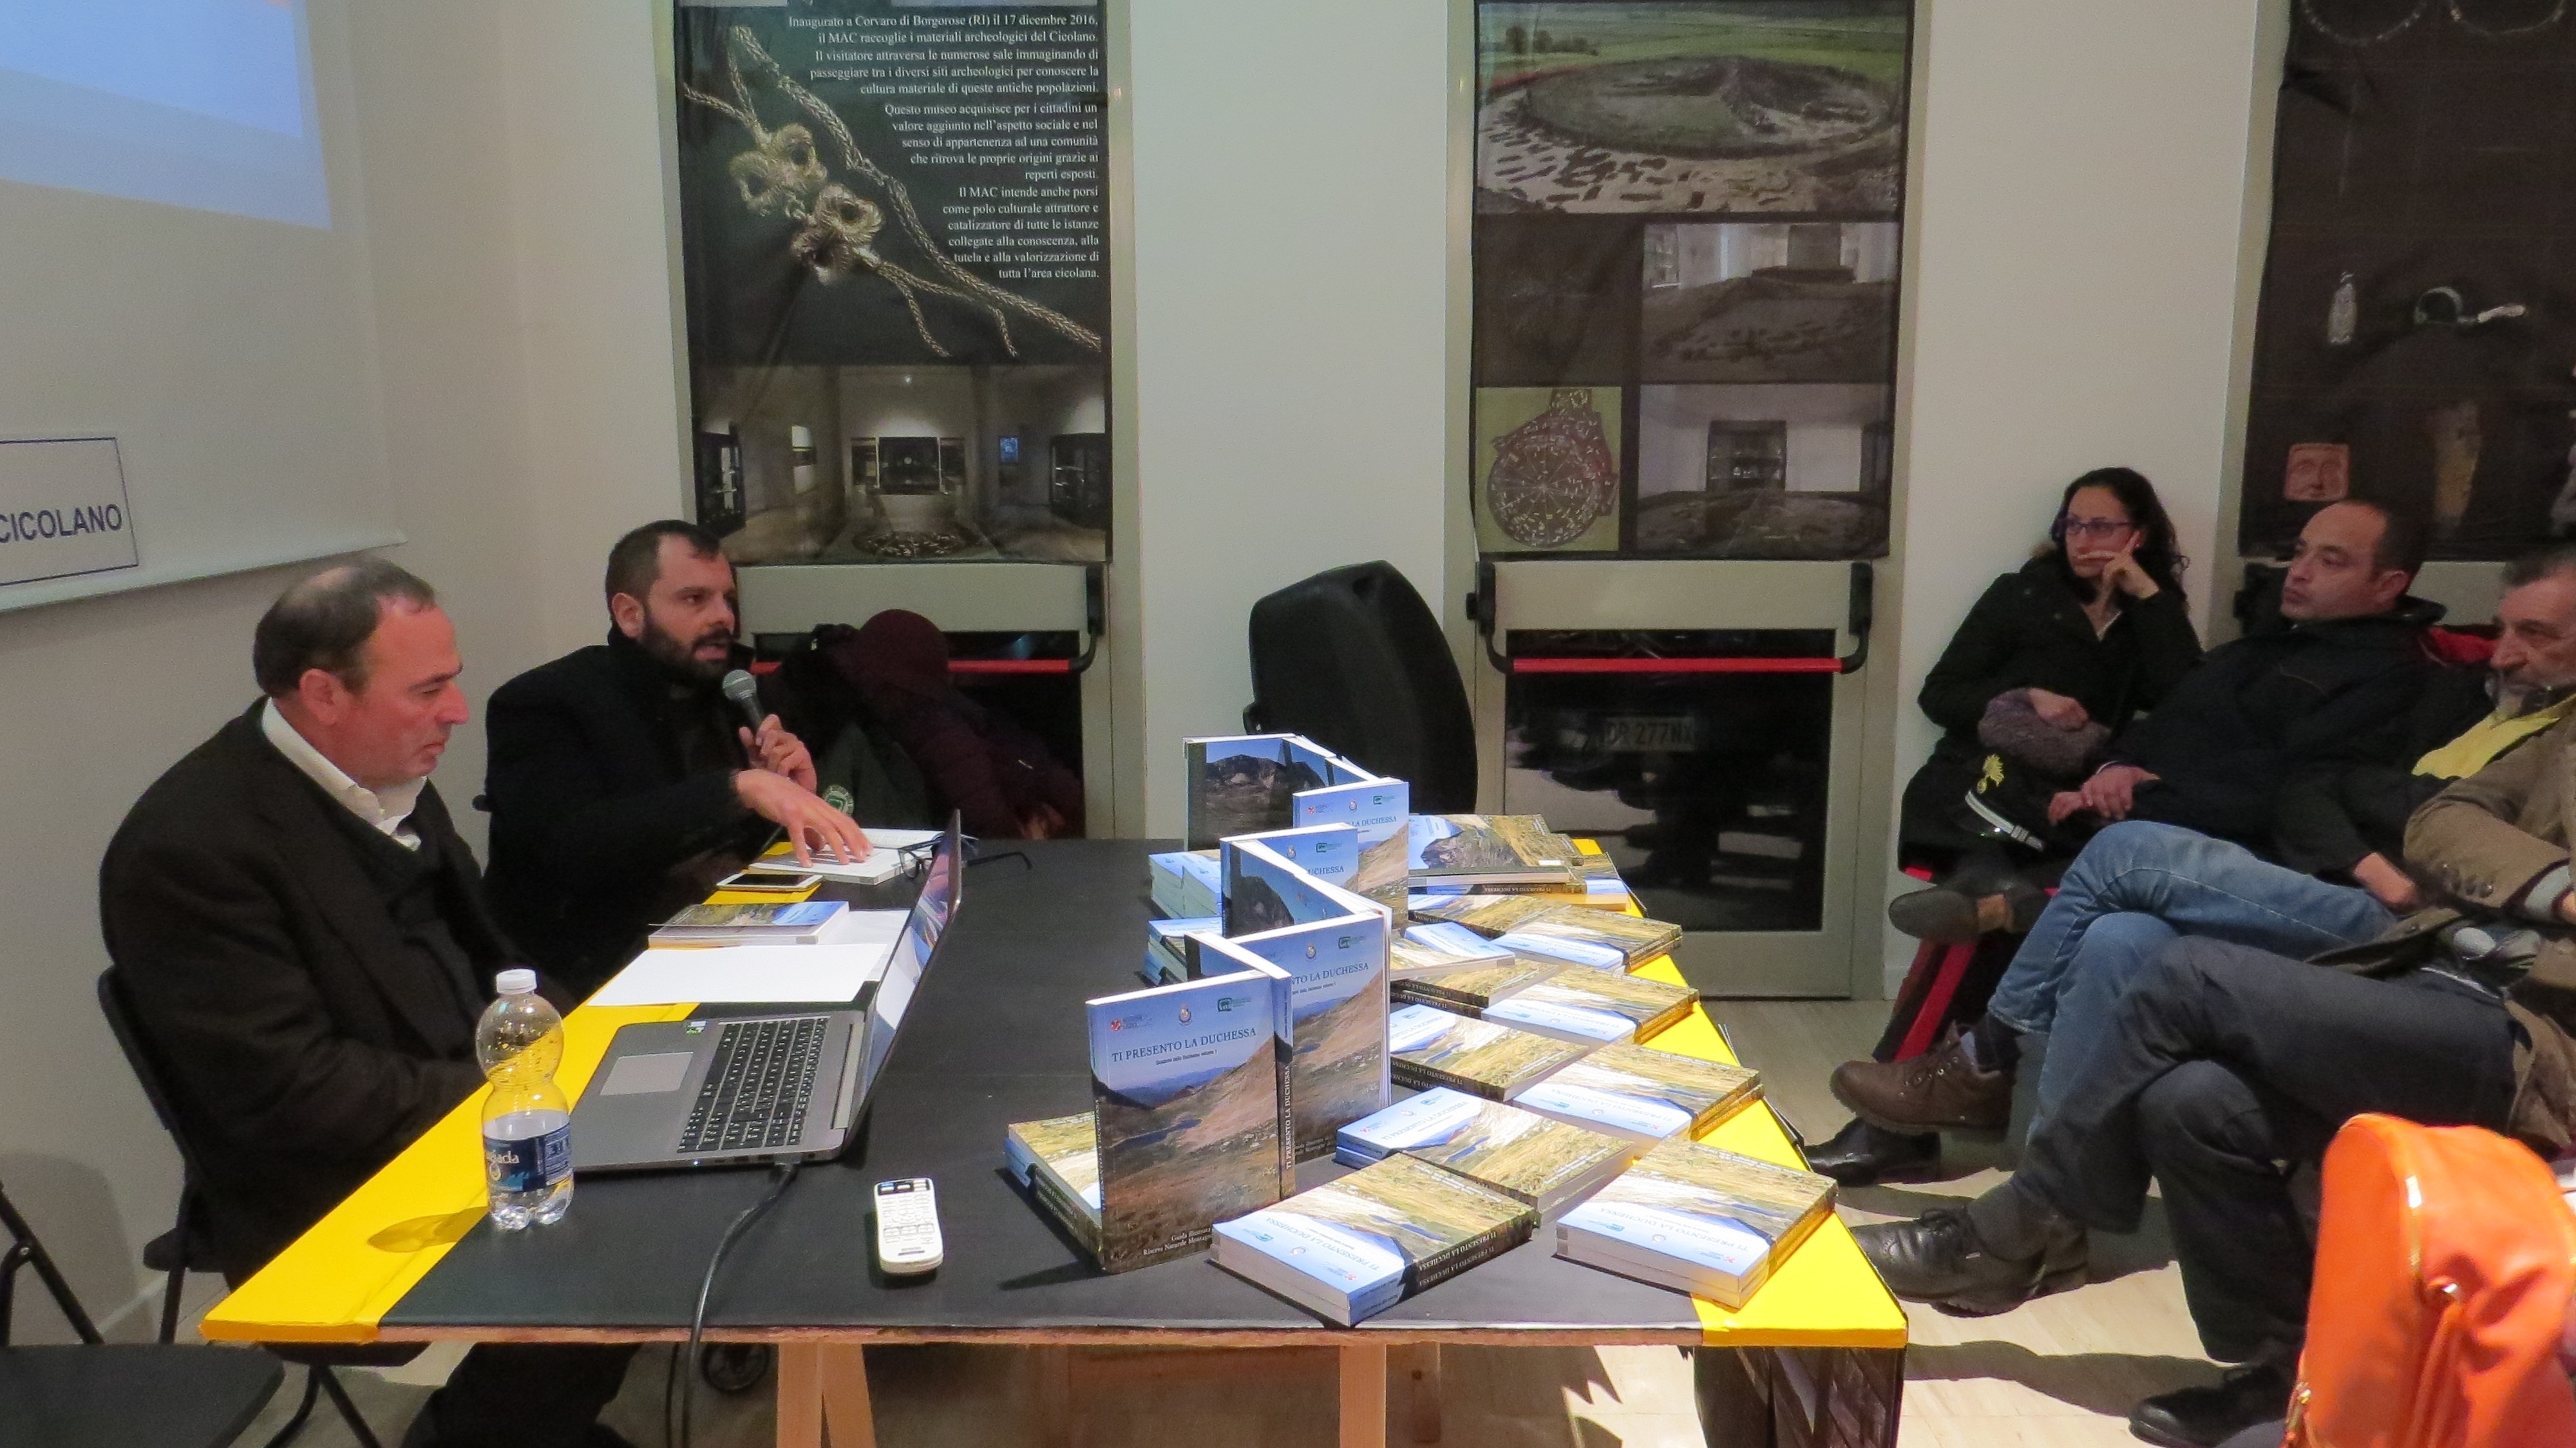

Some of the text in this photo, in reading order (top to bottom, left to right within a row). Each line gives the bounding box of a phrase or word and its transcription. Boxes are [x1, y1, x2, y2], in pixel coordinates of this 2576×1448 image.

[788, 16, 844, 30] Inaugurato
[855, 15, 897, 26] Corvaro
[899, 15, 910, 26] di
[913, 15, 966, 29] Borgorose
[968, 15, 990, 28] (RI)
[993, 14, 1000, 25] il
[1005, 14, 1016, 25] 17
[1018, 14, 1067, 25] dicembre
[819, 33, 826, 44] il
[829, 33, 857, 43] MAC
[860, 33, 907, 46] raccoglie
[916, 32, 961, 43] materiali
[965, 32, 1028, 45] archeologici
[1030, 32, 1046, 42] del
[815, 51, 823, 61] Il
[826, 51, 873, 61] visitatore
[876, 52, 925, 61] attraversa
[928, 50, 938, 61] le
[992, 50, 1013, 60] sale
[1016, 49, 1086, 62] immaginando
[1088, 49, 1099, 59] di
[810, 67, 869, 81] passeggiare
[871, 68, 886, 77] tra
[895, 66, 929, 77] diversi
[933, 66, 948, 77] siti
[951, 66, 1014, 79] archeologici
[1016, 68, 1034, 79] per
[1089, 65, 1099, 75] la
[860, 83, 896, 93] cultura
[898, 83, 946, 93] materiale
[947, 82, 958, 93] di
[961, 84, 994, 96] queste
[996, 82, 1034, 93] antiche
[884, 104, 922, 117] Questo
[959, 103, 1012, 117] acquisisce
[1014, 106, 1031, 116] per
[1039, 102, 1082, 113] cittadini
[892, 120, 924, 131] valore
[926, 120, 971, 133] aggiunto
[1035, 119, 1071, 129] sociale
[1082, 119, 1098, 129] nel
[933, 137, 943, 148] di
[945, 138, 1012, 150] appartenenza
[1014, 137, 1027, 147] ad
[910, 152, 1099, 166] che ritrova le proprie origini grazie ai
[1025, 169, 1057, 182] reperti
[959, 186, 1098, 199] Il MAC intende anche porsi
[972, 204, 996, 216] polo
[998, 203, 1042, 213] culturale
[1045, 204, 1090, 213] attrattore
[947, 219, 1099, 230] catalizzatore di tutte le istanze
[948, 236, 994, 249] collegate
[996, 236, 1015, 246] alla
[1081, 235, 1099, 245] alla
[954, 252, 982, 263] tutela
[992, 252, 1011, 263] alla
[1014, 252, 1087, 262] valorizzazione
[1089, 252, 1099, 262] di
[998, 270, 1021, 279] tutta
[0, 504, 122, 543] CICOLANO
[1362, 815, 1397, 826] DUCHESSA
[1308, 866, 1344, 875] UCHESSA
[1310, 971, 1321, 982] LA
[1322, 962, 1369, 979] DUCHESSA
[1112, 1051, 1122, 1062] TI
[1125, 1041, 1182, 1060] PRESENTO
[1185, 1038, 1198, 1049] LA
[1200, 1027, 1256, 1046] DUCHESSA
[1600, 1208, 1658, 1226] DUCHESSA
[1265, 1217, 1311, 1239] DUCHESSA
[1660, 1222, 1673, 1231] LA
[1311, 1236, 1323, 1245] LA
[1675, 1228, 1732, 1248] PRESENTO
[1322, 1242, 1370, 1266] PRESENTO
